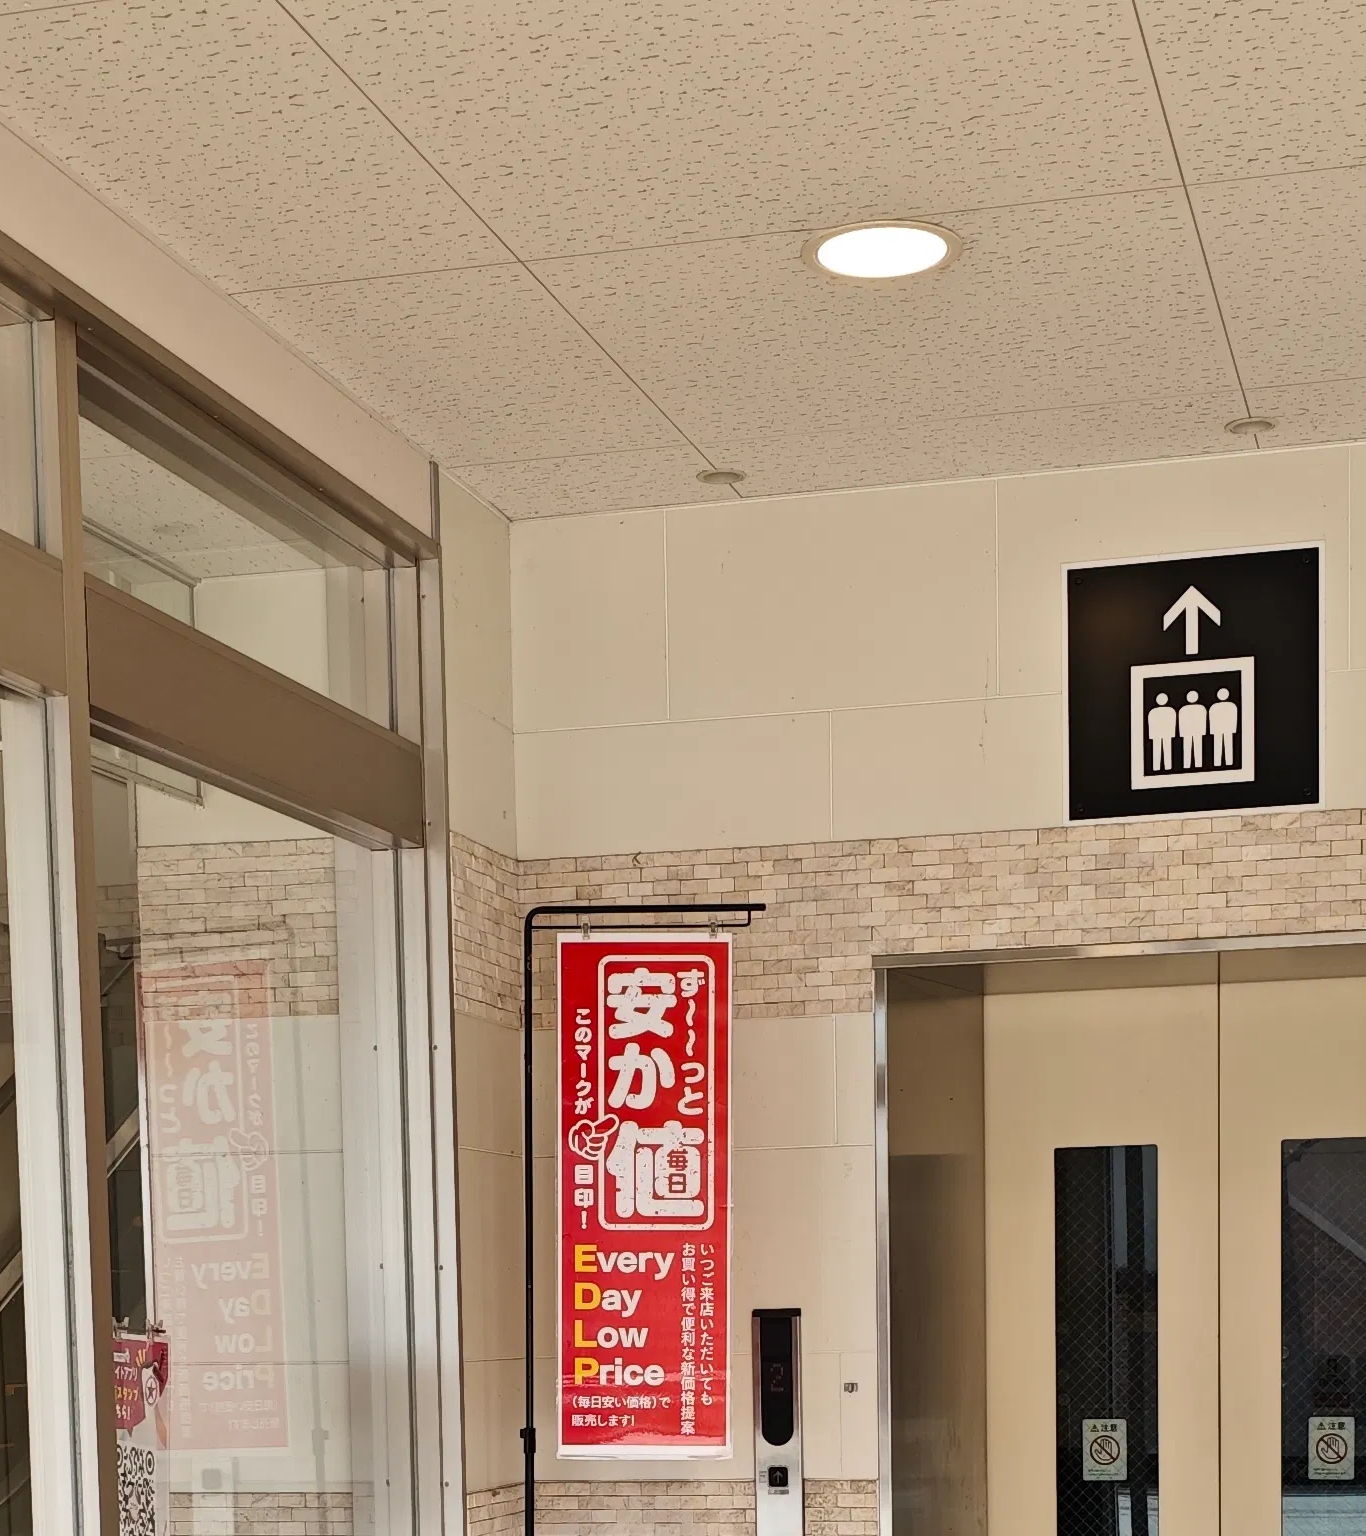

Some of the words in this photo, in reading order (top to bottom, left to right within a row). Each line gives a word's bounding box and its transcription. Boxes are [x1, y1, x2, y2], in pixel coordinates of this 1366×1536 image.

[575, 1008, 594, 1114] このマークが
[606, 967, 705, 1218] 安か値
[667, 1148, 689, 1194] 毎日
[574, 1164, 594, 1229] 目印!
[574, 1245, 675, 1280] Every
[574, 1282, 642, 1317] Day
[574, 1320, 648, 1348] Low
[681, 1243, 695, 1435] お買い得で便利な新価格提案
[700, 1243, 714, 1405] いつご来店いただいても
[574, 1358, 665, 1386] Price
[572, 1414, 634, 1426] 販売します!
